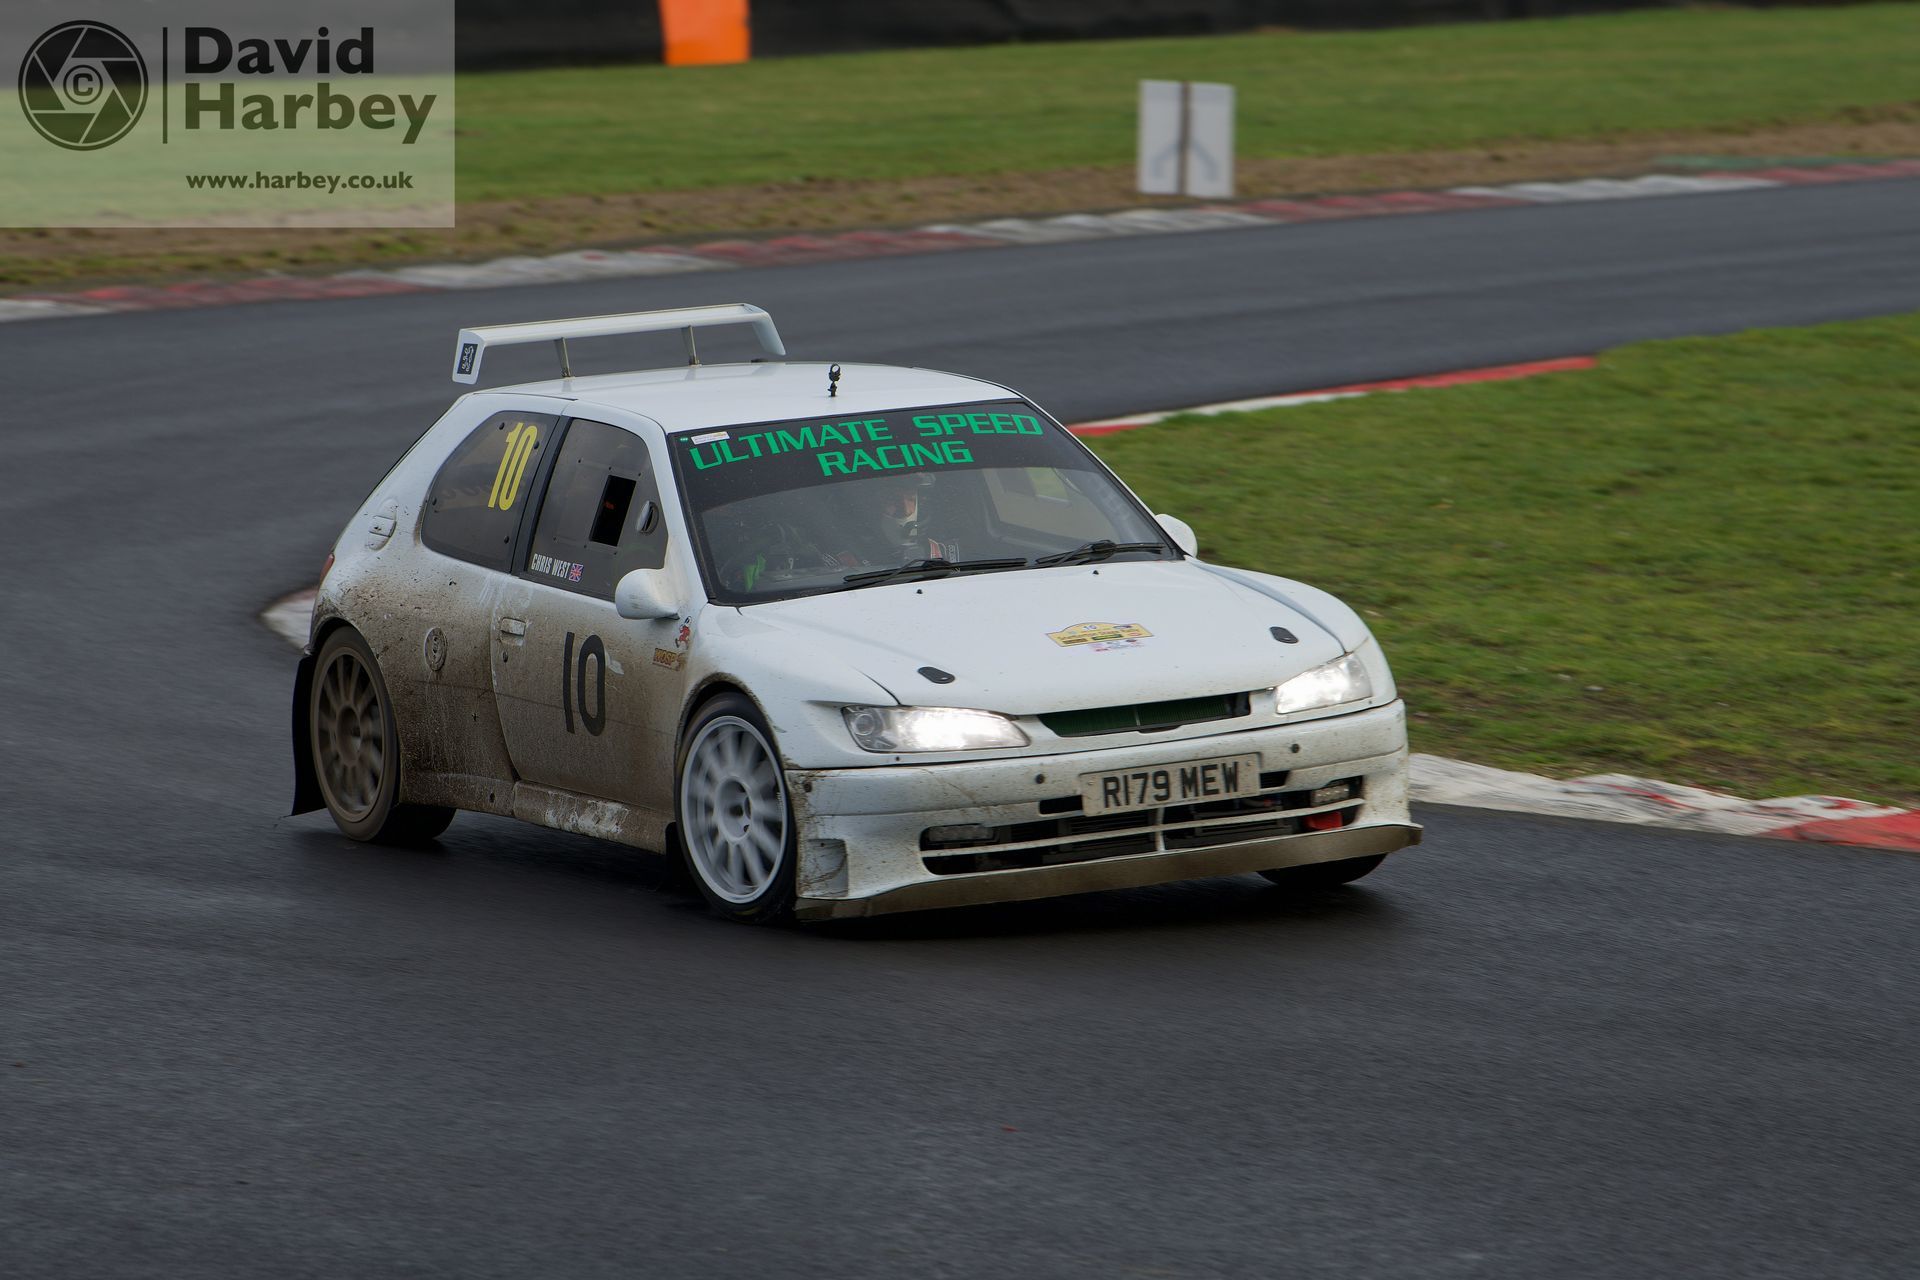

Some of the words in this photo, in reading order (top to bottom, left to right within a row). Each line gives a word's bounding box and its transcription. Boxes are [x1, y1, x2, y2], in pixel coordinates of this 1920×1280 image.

[488, 422, 539, 511] 10
[689, 418, 892, 470] ULTIMATE
[912, 413, 1043, 438] SPEED
[817, 440, 974, 476] RACING
[531, 553, 553, 574] CHRIS
[551, 558, 571, 579] WEST
[563, 631, 606, 737] 10
[1102, 770, 1171, 809] R179
[1180, 761, 1239, 799] MEW
